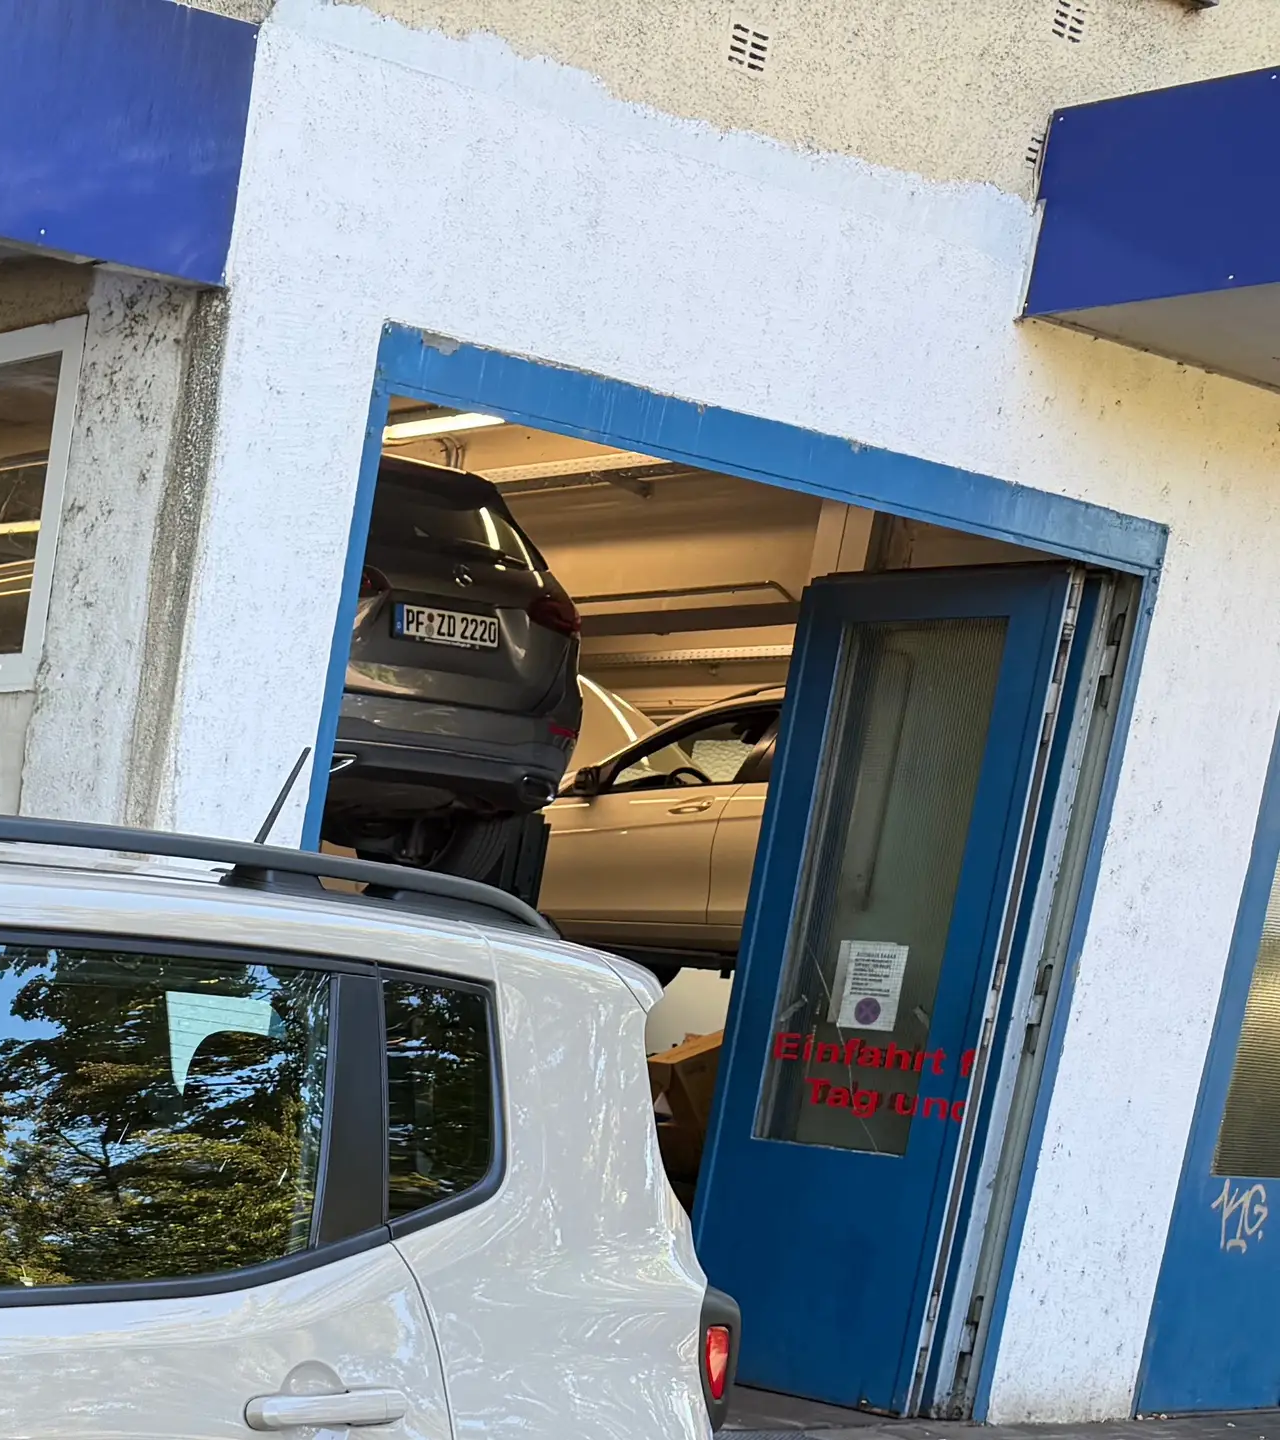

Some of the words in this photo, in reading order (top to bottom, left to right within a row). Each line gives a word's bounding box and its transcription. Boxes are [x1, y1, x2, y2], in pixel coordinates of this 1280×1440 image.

[405, 608, 425, 633] PF
[436, 613, 457, 638] ZD
[460, 616, 497, 644] 2220
[773, 1031, 947, 1076] Einfahrt
[804, 1076, 880, 1119] Tag
